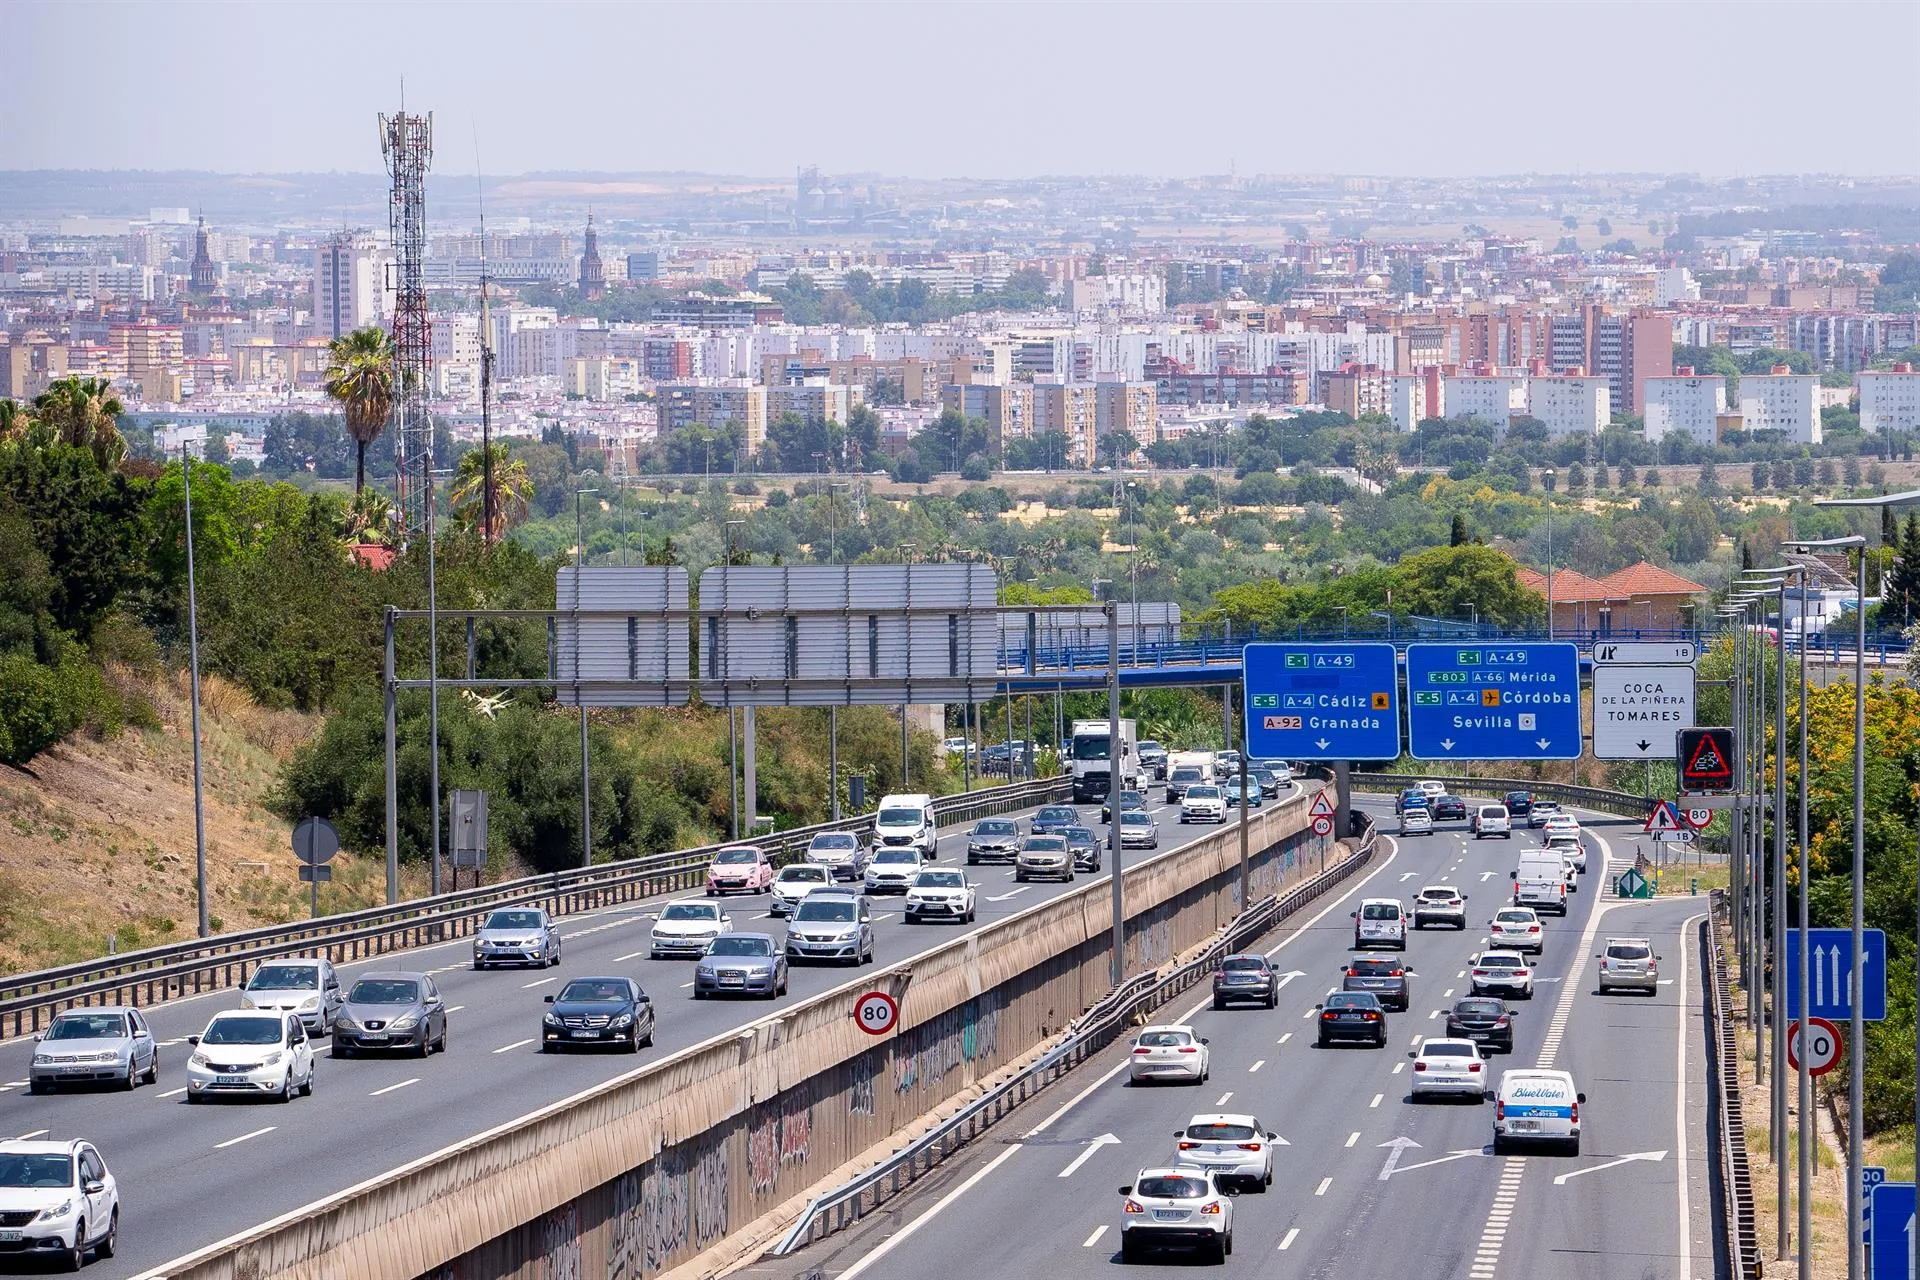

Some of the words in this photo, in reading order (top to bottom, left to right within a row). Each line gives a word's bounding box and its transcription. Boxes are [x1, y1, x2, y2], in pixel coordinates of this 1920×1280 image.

[1287, 656, 1306, 666] E-1
[1316, 656, 1352, 666] A-49
[1460, 653, 1479, 662] E-1
[1489, 652, 1526, 662] A-49
[1430, 674, 1466, 682] E-803
[1510, 672, 1556, 682] Mérida
[1624, 684, 1664, 693] COCA
[1253, 696, 1276, 706] E-5
[1287, 696, 1312, 706] A-4
[1319, 694, 1366, 707] Cádiz
[1416, 693, 1439, 703] E-5
[1450, 693, 1475, 703] A-4
[1503, 691, 1571, 703] Córdoba
[1642, 696, 1685, 704] PIÑERA
[1608, 712, 1680, 721] TOMARES
[1266, 718, 1300, 727] A-92
[1310, 716, 1380, 728] Granada
[1454, 716, 1512, 728] Sevilla
[1692, 810, 1707, 818] 80
[864, 1006, 887, 1020] 80
[1512, 1088, 1564, 1098] BlueWater
